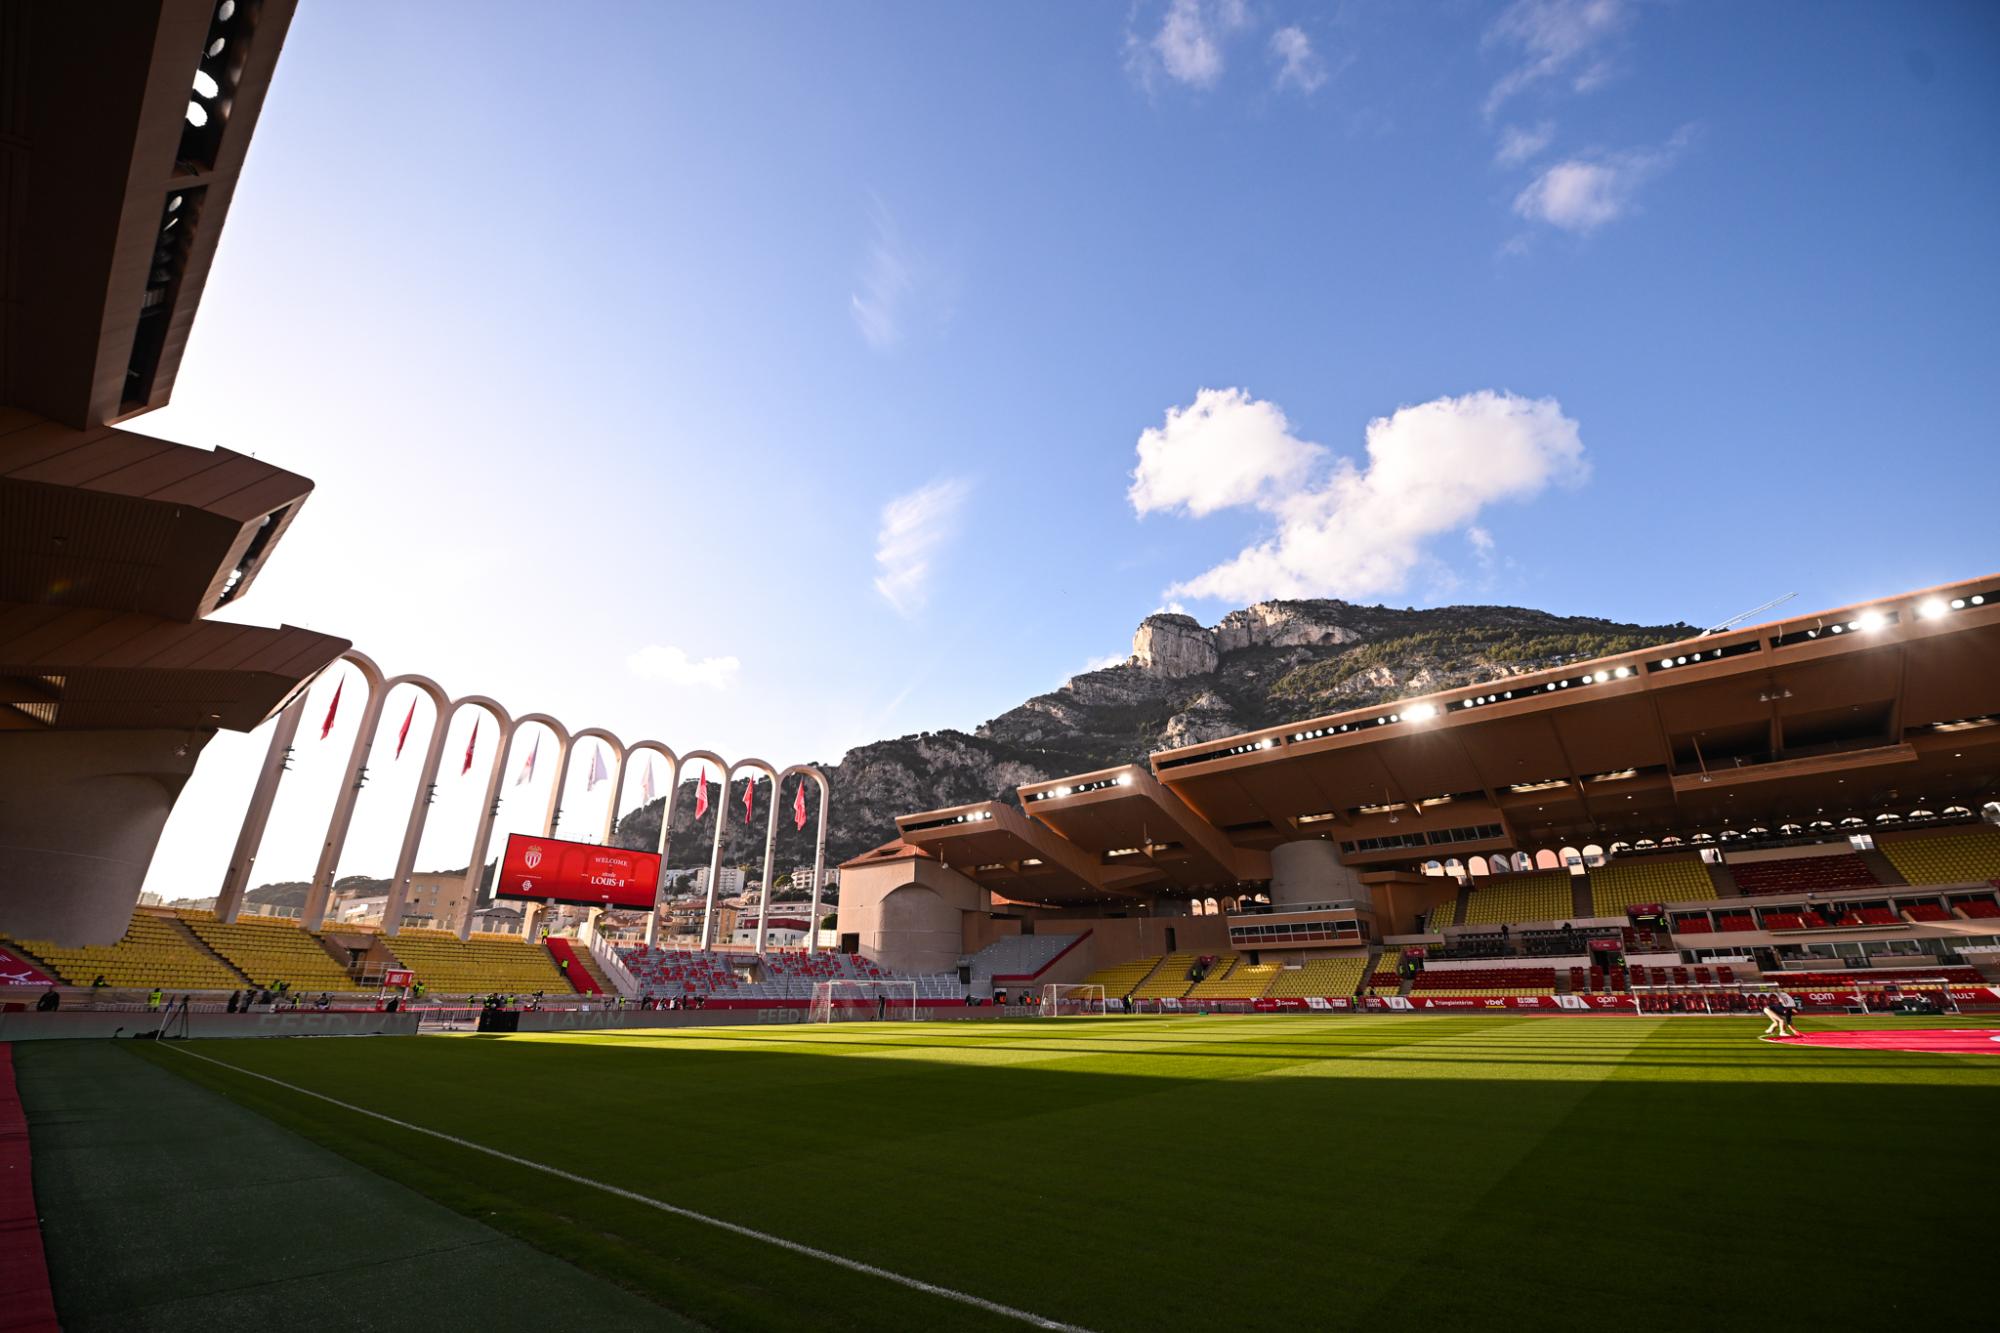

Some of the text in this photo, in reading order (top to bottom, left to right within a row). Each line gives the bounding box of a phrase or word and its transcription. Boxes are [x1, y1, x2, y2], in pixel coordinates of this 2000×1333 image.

[595, 857, 628, 867] WELCOME
[1596, 996, 1618, 1005] apm
[1809, 993, 1835, 1003] apm
[1951, 992, 1976, 1000] AULT
[548, 1012, 625, 1028] LATAM
[757, 1008, 800, 1023] FEED
